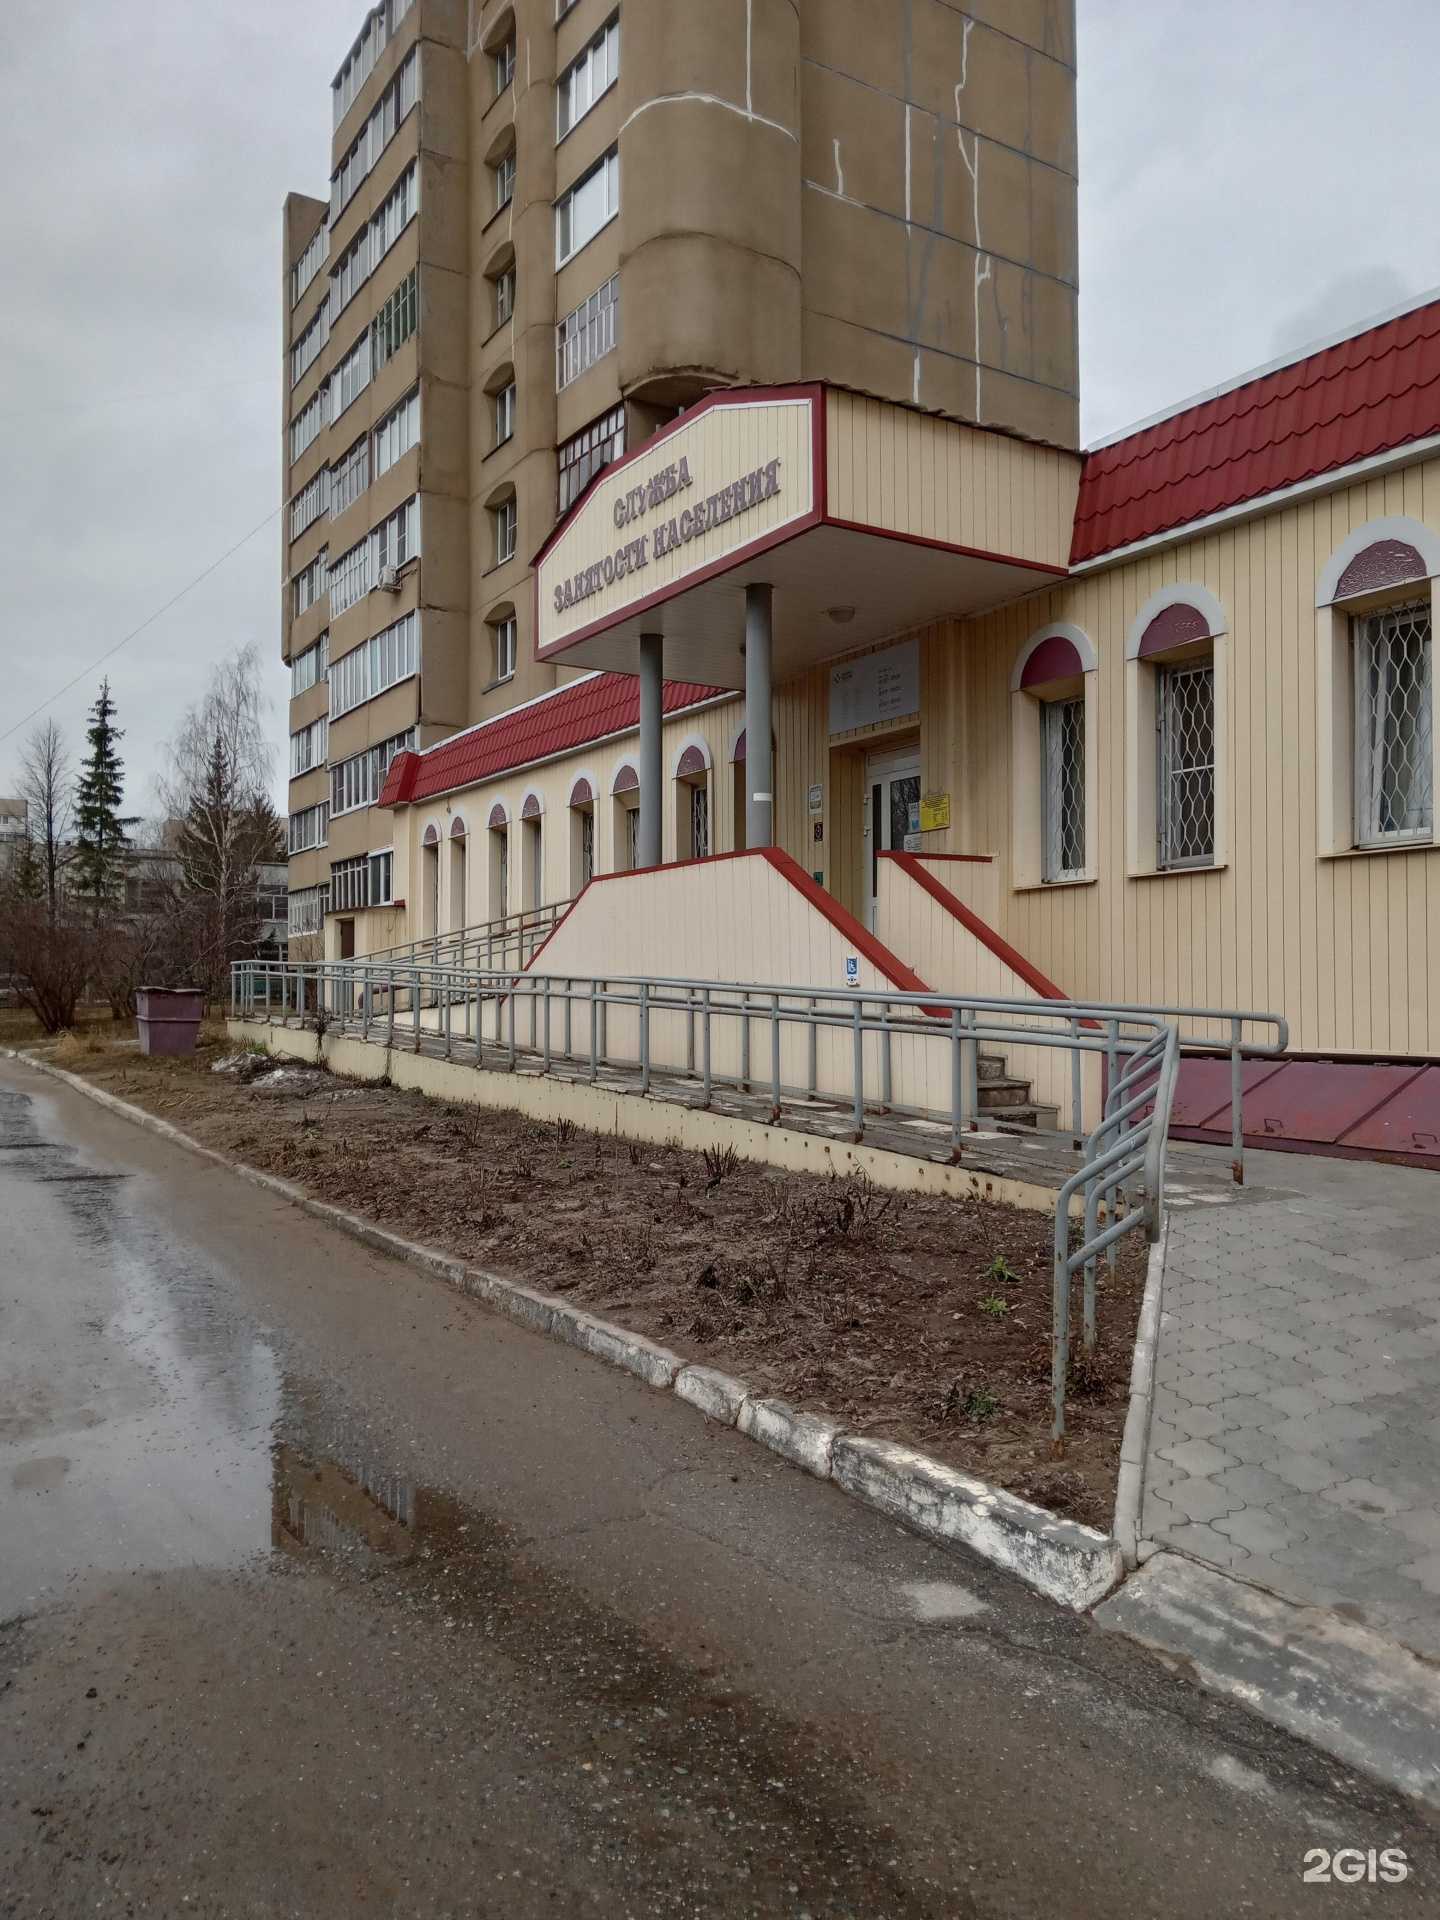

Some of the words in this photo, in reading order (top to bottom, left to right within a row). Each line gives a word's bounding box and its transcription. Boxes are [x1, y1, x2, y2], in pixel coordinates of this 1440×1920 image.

[554, 535, 648, 613] ЗАНЯТОСТИ
[653, 457, 781, 559] НАСЕЛЕНИЯ
[613, 456, 693, 528] СЛУЖБА
